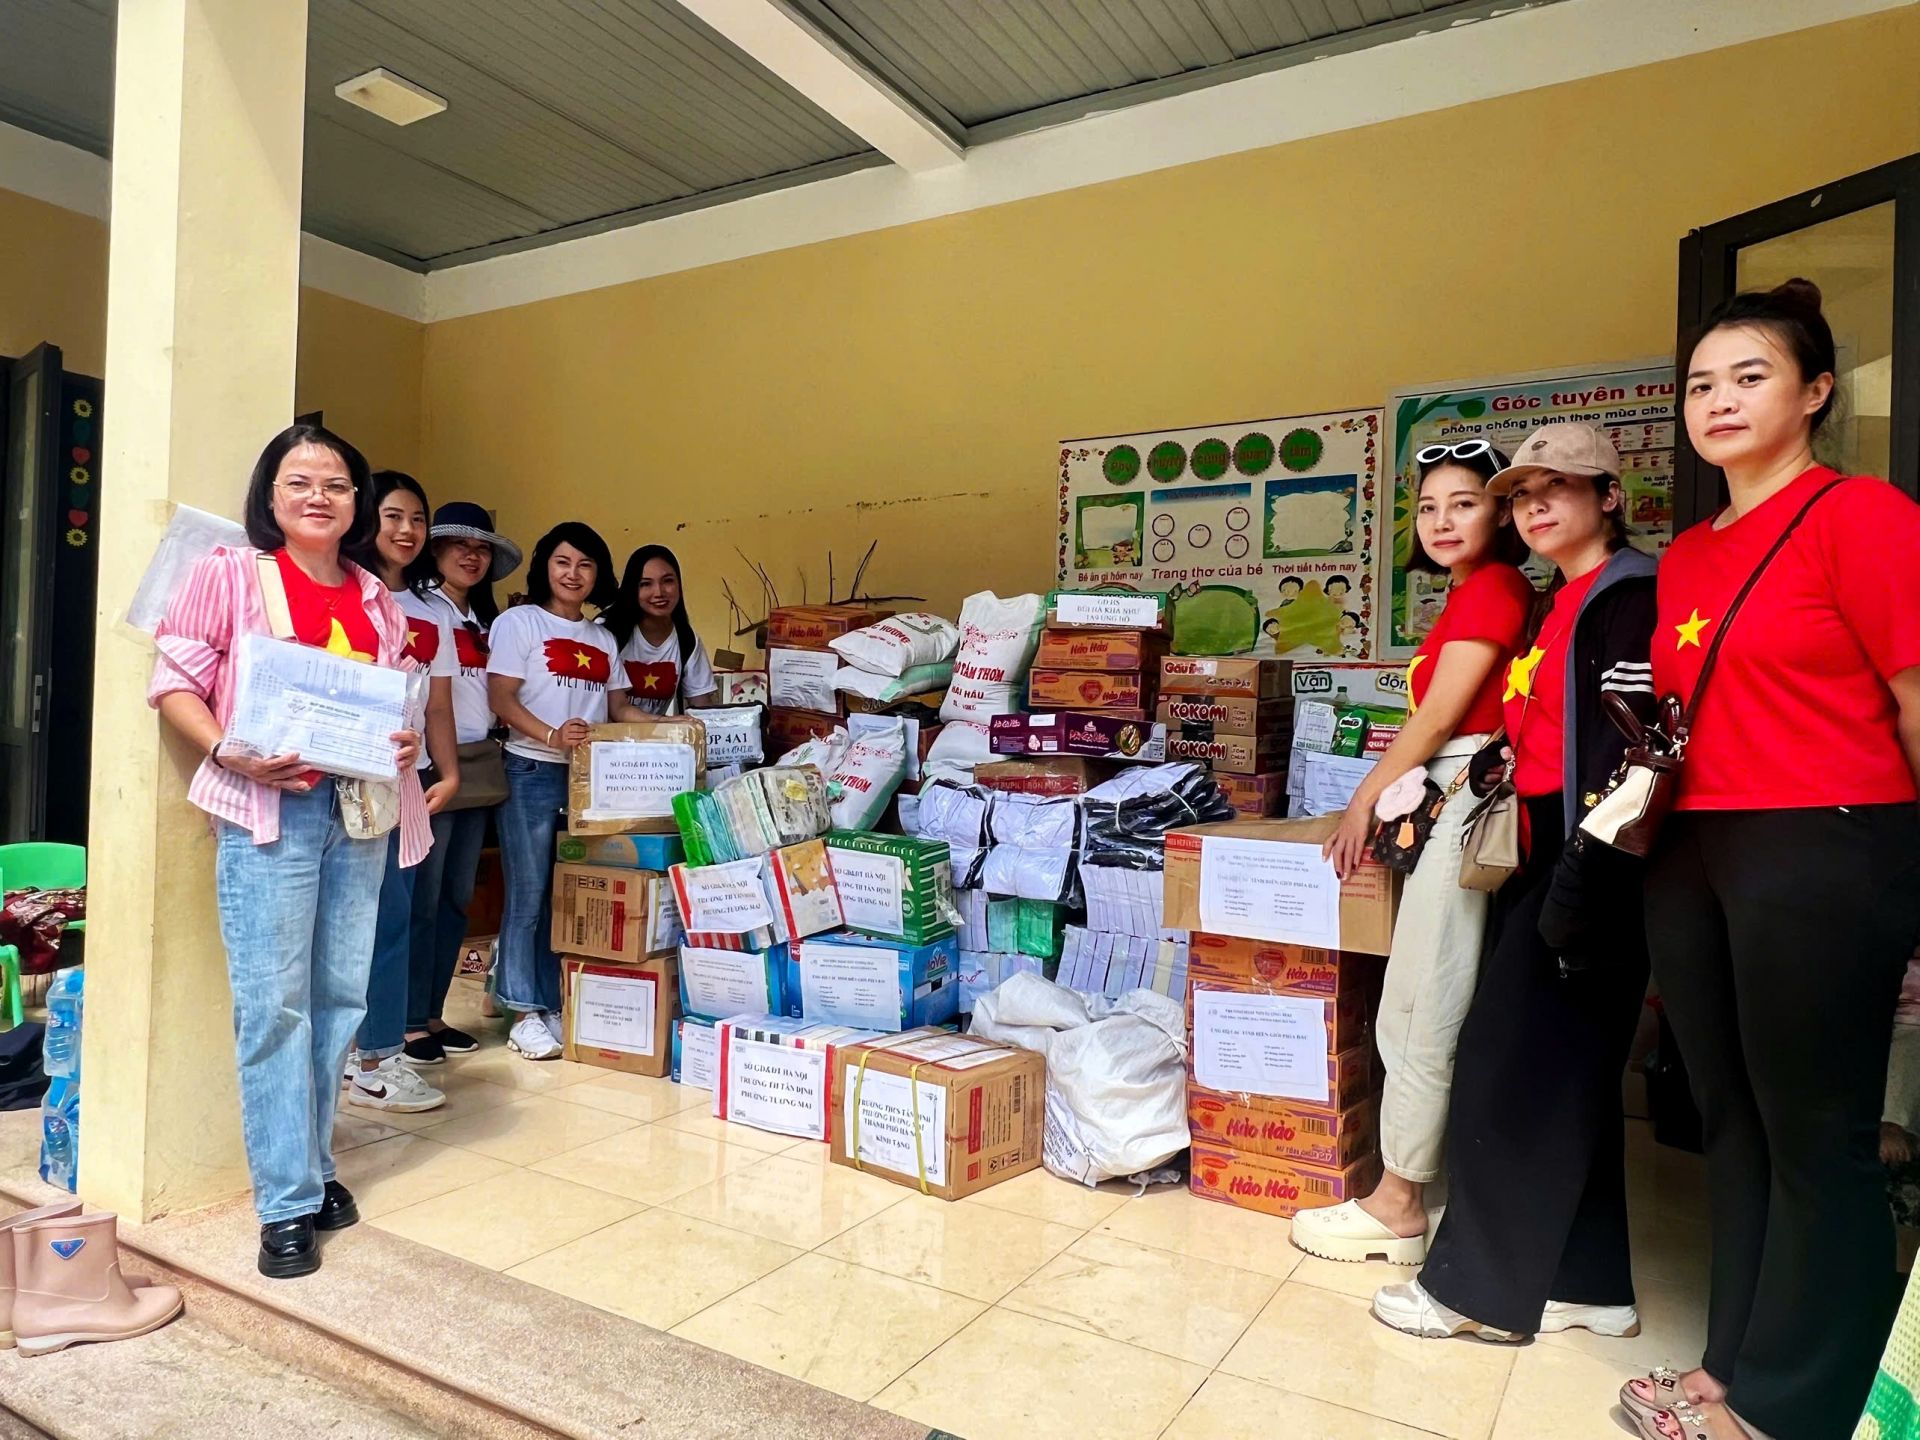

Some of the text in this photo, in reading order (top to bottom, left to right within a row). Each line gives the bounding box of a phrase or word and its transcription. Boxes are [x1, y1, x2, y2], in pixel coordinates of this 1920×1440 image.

[1491, 383, 1675, 412] Góc tuyên tru
[1441, 423, 1482, 436] phòng
[1486, 417, 1527, 432] chống
[1570, 411, 1600, 423] theo
[1605, 406, 1637, 419] mùa
[1641, 404, 1668, 416] cho
[1078, 572, 1089, 582] Bé
[1110, 571, 1127, 582] hôm
[1129, 572, 1144, 582] nay
[1152, 565, 1263, 581] Trang thơ của bé
[1272, 564, 1294, 574] Thời
[1315, 562, 1336, 573] hôm
[1339, 563, 1358, 574] nay
[977, 668, 1005, 682] THƠM
[1379, 674, 1408, 691] độn
[1169, 703, 1229, 722] KOKOMI
[725, 733, 747, 744] 4A1
[1169, 740, 1228, 760] KOKOMI
[1287, 967, 1307, 980] Hảo
[1226, 1116, 1296, 1141] Hảo Hảo
[1229, 1175, 1300, 1201] Hảo Hảo
